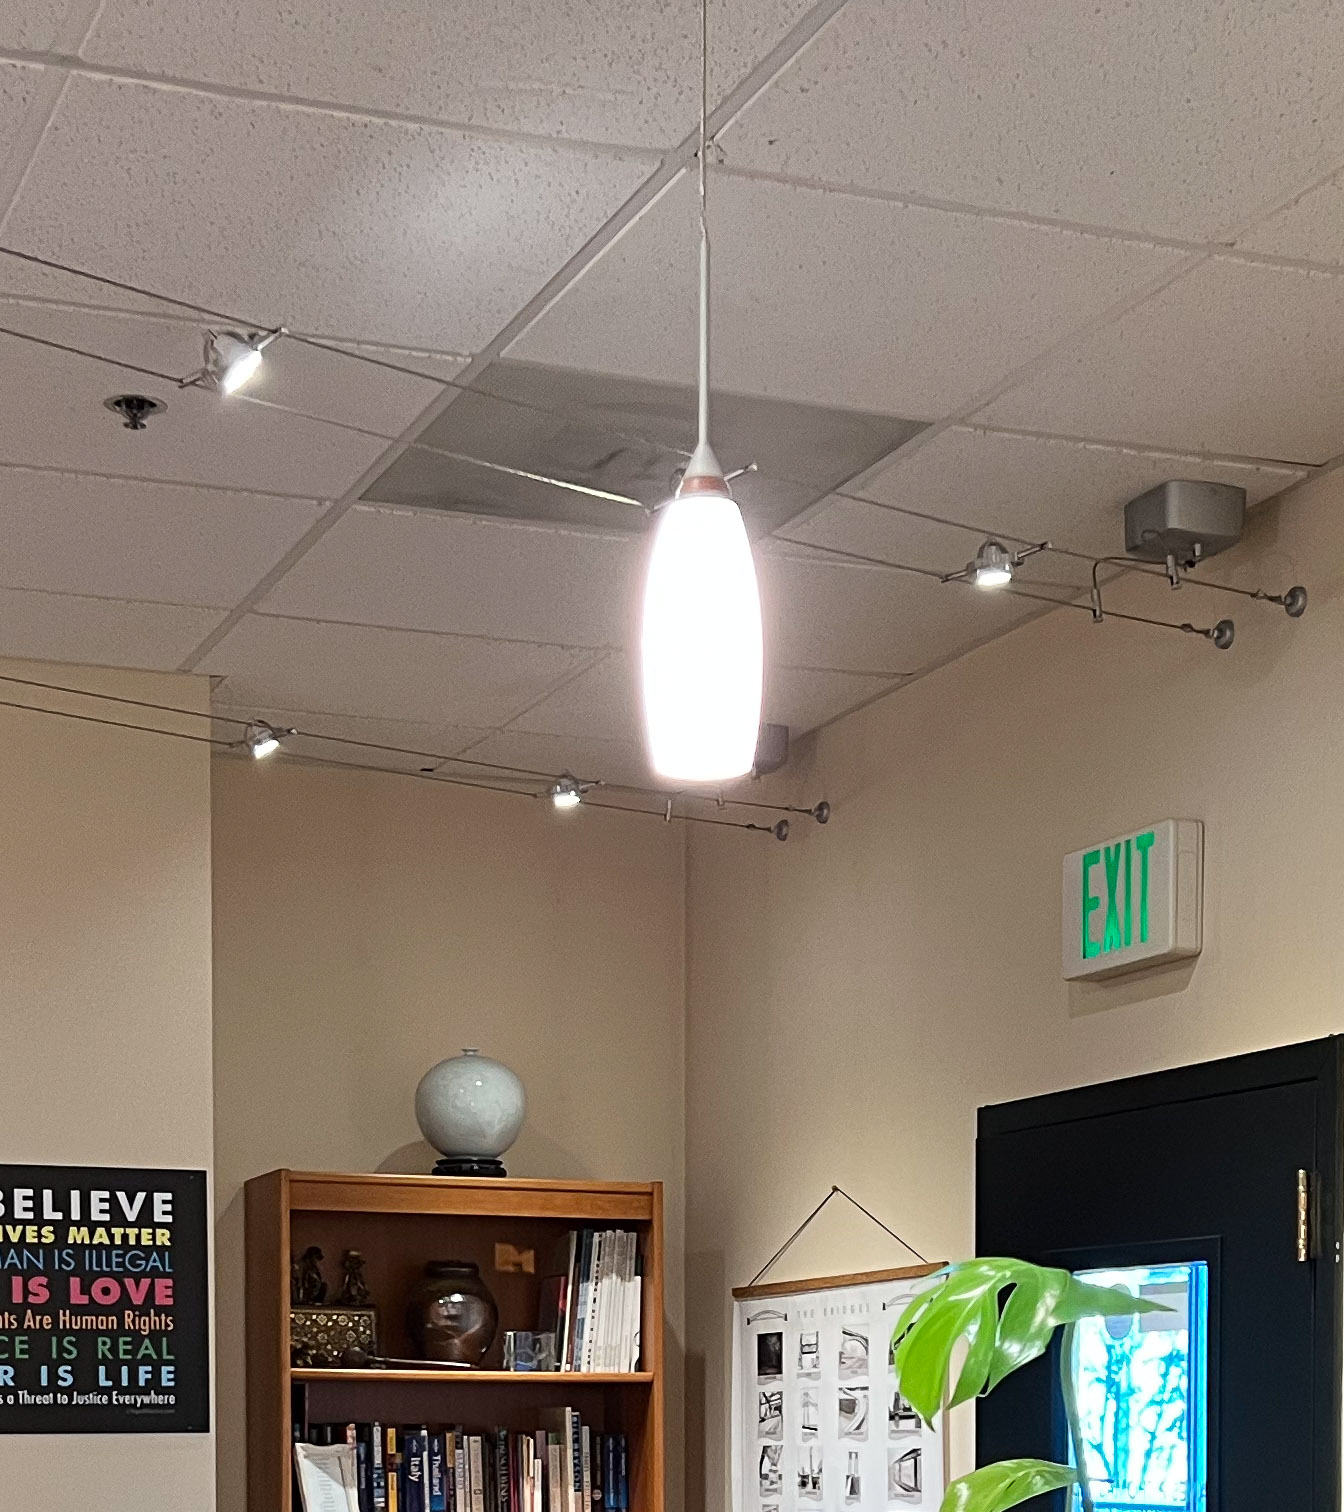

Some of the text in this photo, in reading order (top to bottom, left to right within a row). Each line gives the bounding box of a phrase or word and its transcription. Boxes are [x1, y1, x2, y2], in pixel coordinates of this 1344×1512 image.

[1082, 831, 1155, 959] EXIT
[68, 1226, 171, 1247] MATTER
[55, 1249, 75, 1271] IS
[85, 1250, 174, 1272] ILLEGAL
[12, 1276, 50, 1304] IS
[70, 1278, 174, 1306] LOVE
[24, 1310, 52, 1330] Are
[59, 1310, 117, 1330] Human
[124, 1310, 174, 1335] Rights
[51, 1336, 78, 1360] IS
[97, 1337, 175, 1360] REAL
[41, 1366, 74, 1387] IS
[98, 1366, 175, 1387] LIFE
[7, 1394, 14, 1406] a
[18, 1391, 54, 1406] Threat
[57, 1392, 68, 1406] to
[71, 1392, 109, 1406] Justice
[112, 1391, 175, 1408] Everywhere
[408, 1457, 421, 1482] Italy
[432, 1455, 442, 1495] Thailand
